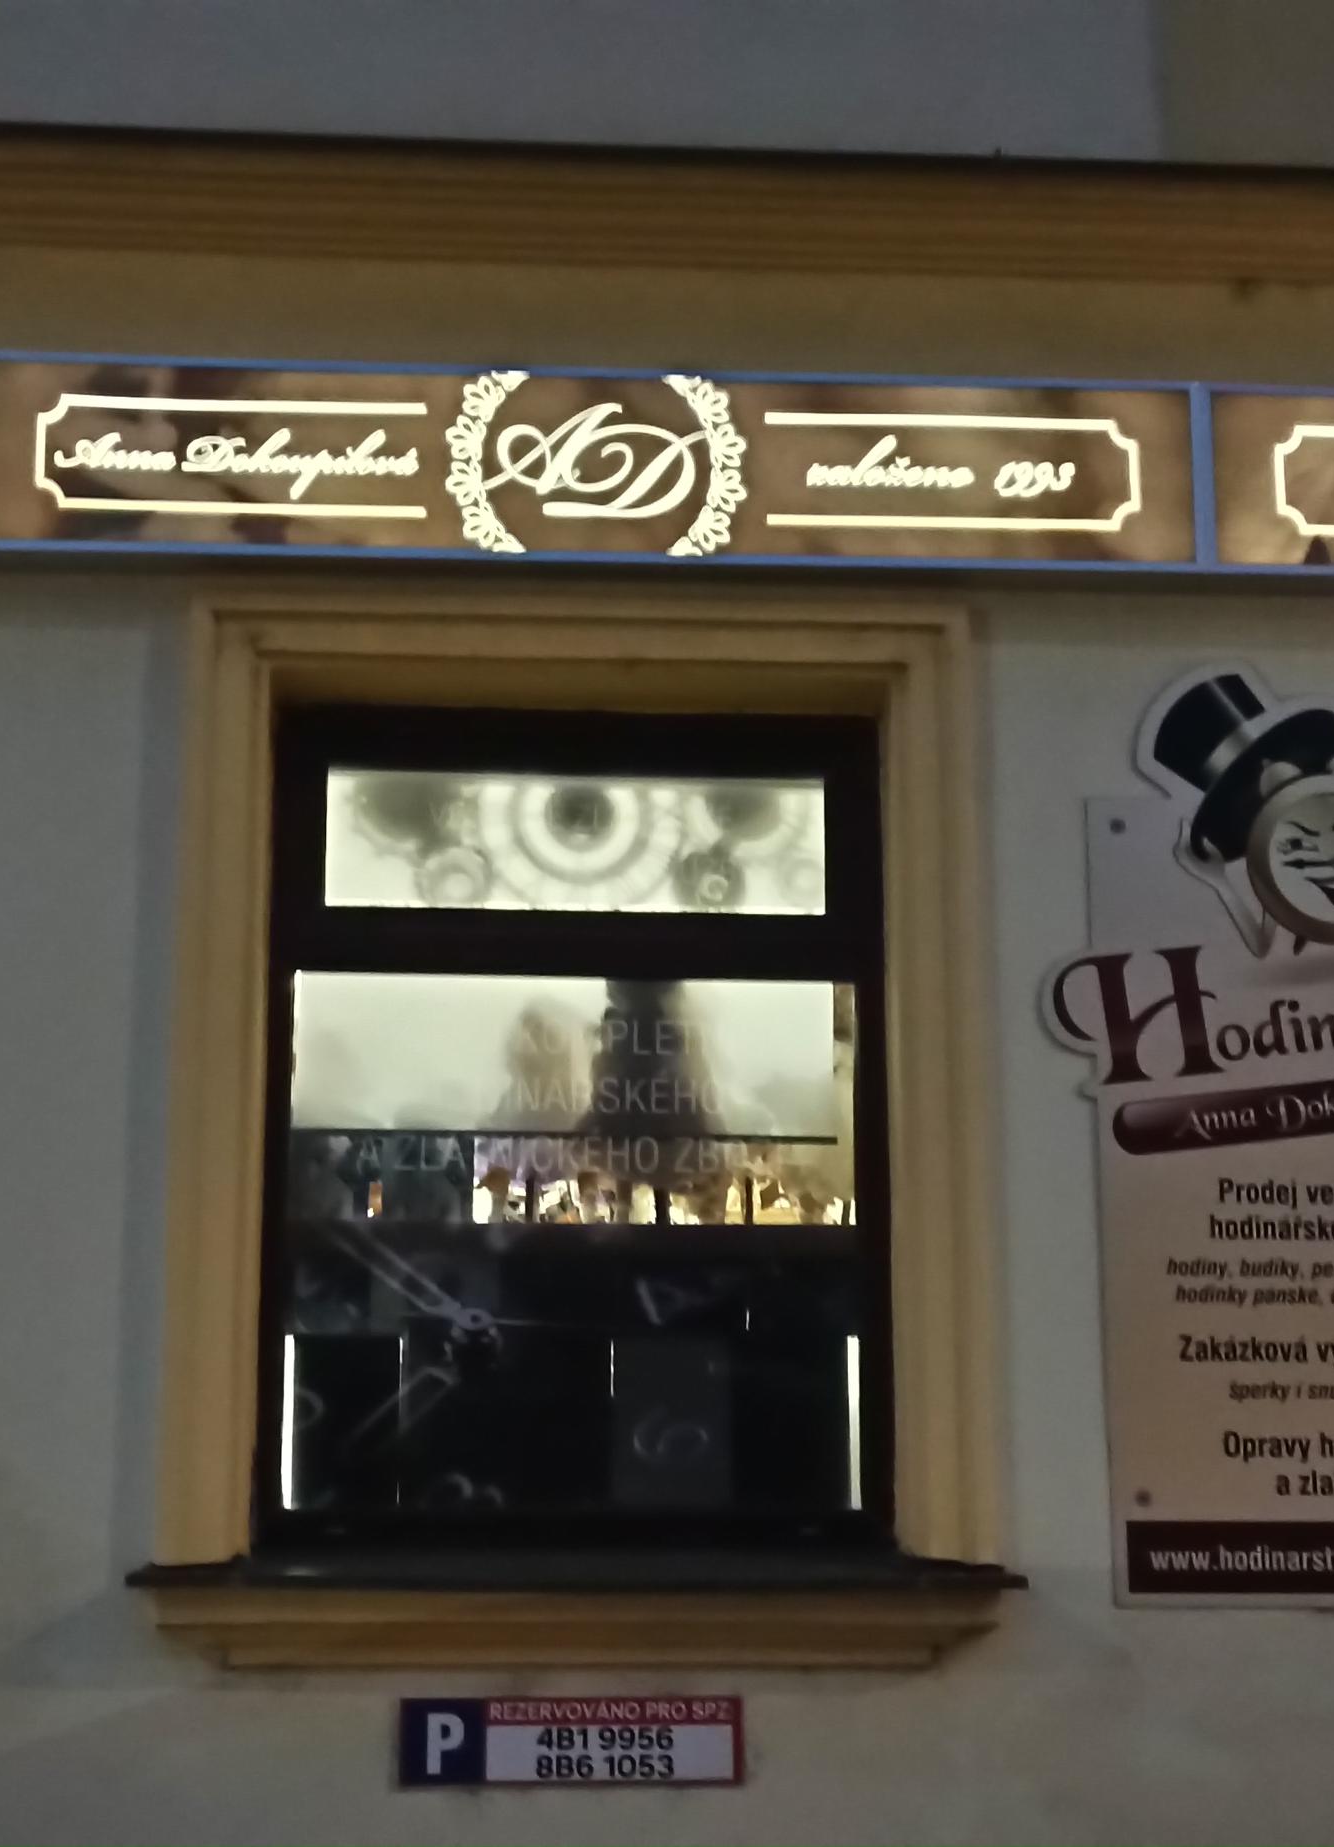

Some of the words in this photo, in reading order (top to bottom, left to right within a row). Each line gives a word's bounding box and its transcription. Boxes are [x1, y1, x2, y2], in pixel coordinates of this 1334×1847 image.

[54, 432, 176, 469] Anna
[482, 402, 709, 518] AD
[806, 434, 974, 488] založeno
[1175, 1104, 1257, 1142] Anna
[1218, 1177, 1298, 1209] Prodej
[1176, 1284, 1248, 1306] hodinky
[1178, 1334, 1308, 1362] Zakázková
[1229, 1380, 1291, 1404] šperky
[1223, 1429, 1311, 1463] Opravy
[1275, 1475, 1291, 1497] a
[489, 1701, 642, 1722] REZERVOVÁNO
[645, 1702, 687, 1722] PRO
[426, 1712, 465, 1775] P
[536, 1728, 589, 1751] 4B1
[598, 1728, 675, 1751] 9956
[536, 1754, 594, 1779] 8B6
[604, 1755, 675, 1779] 1053
